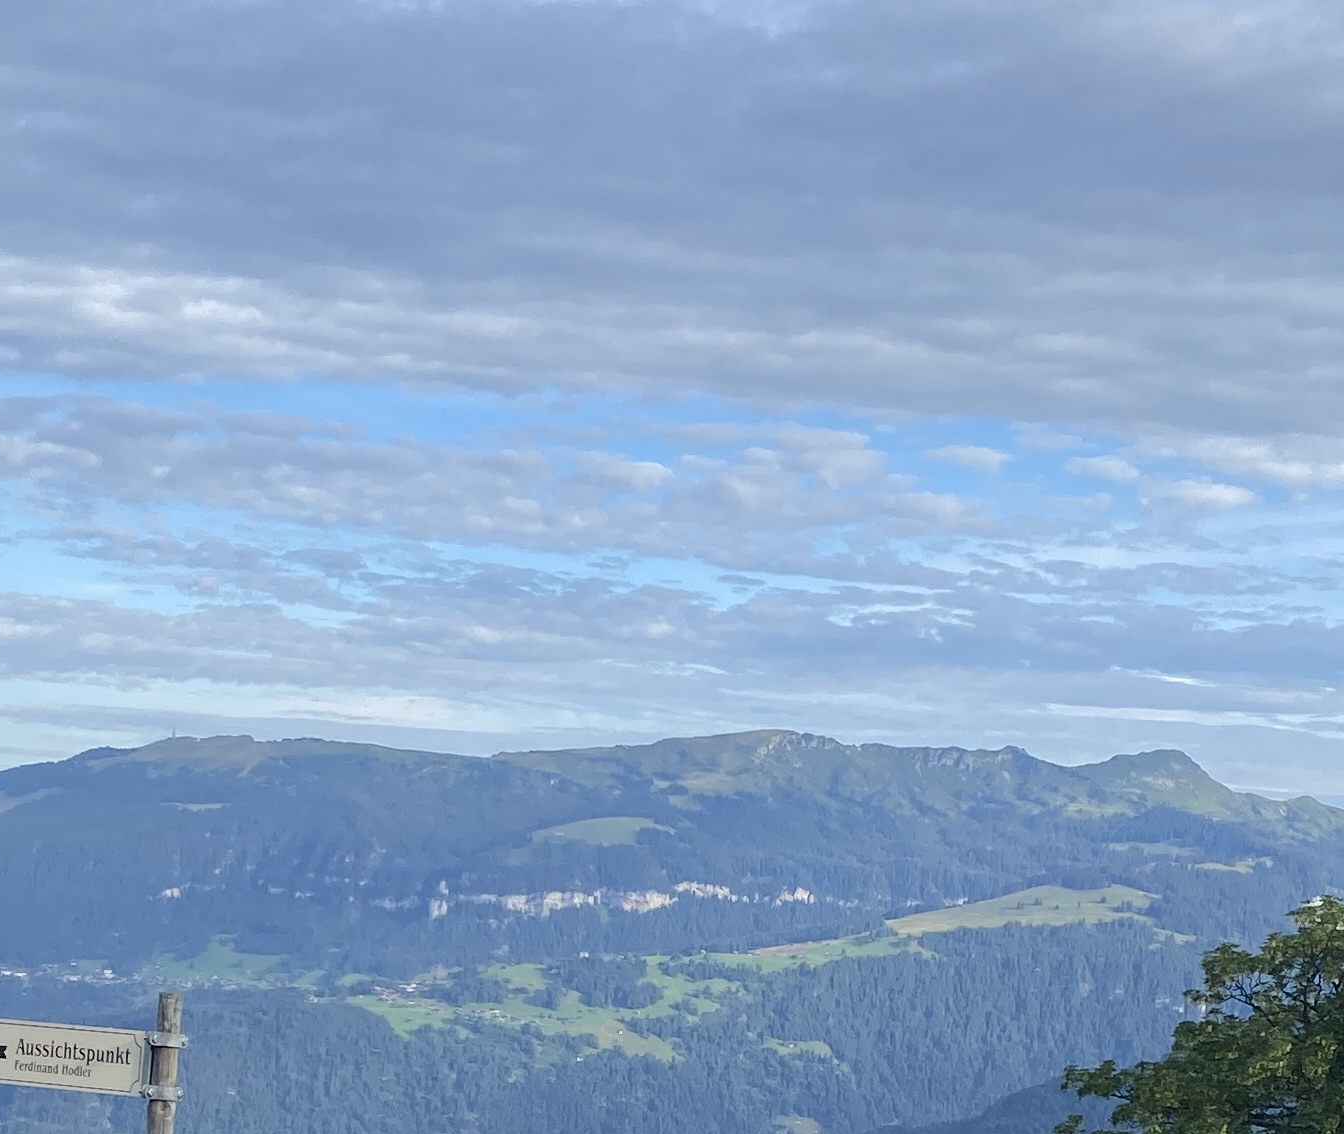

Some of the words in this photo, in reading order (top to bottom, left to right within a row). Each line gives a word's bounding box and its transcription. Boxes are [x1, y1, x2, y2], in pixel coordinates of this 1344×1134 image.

[15, 1038, 132, 1066] Aussichtspunkt
[14, 1059, 59, 1075] Ferdinand
[61, 1065, 92, 1078] Hodler
